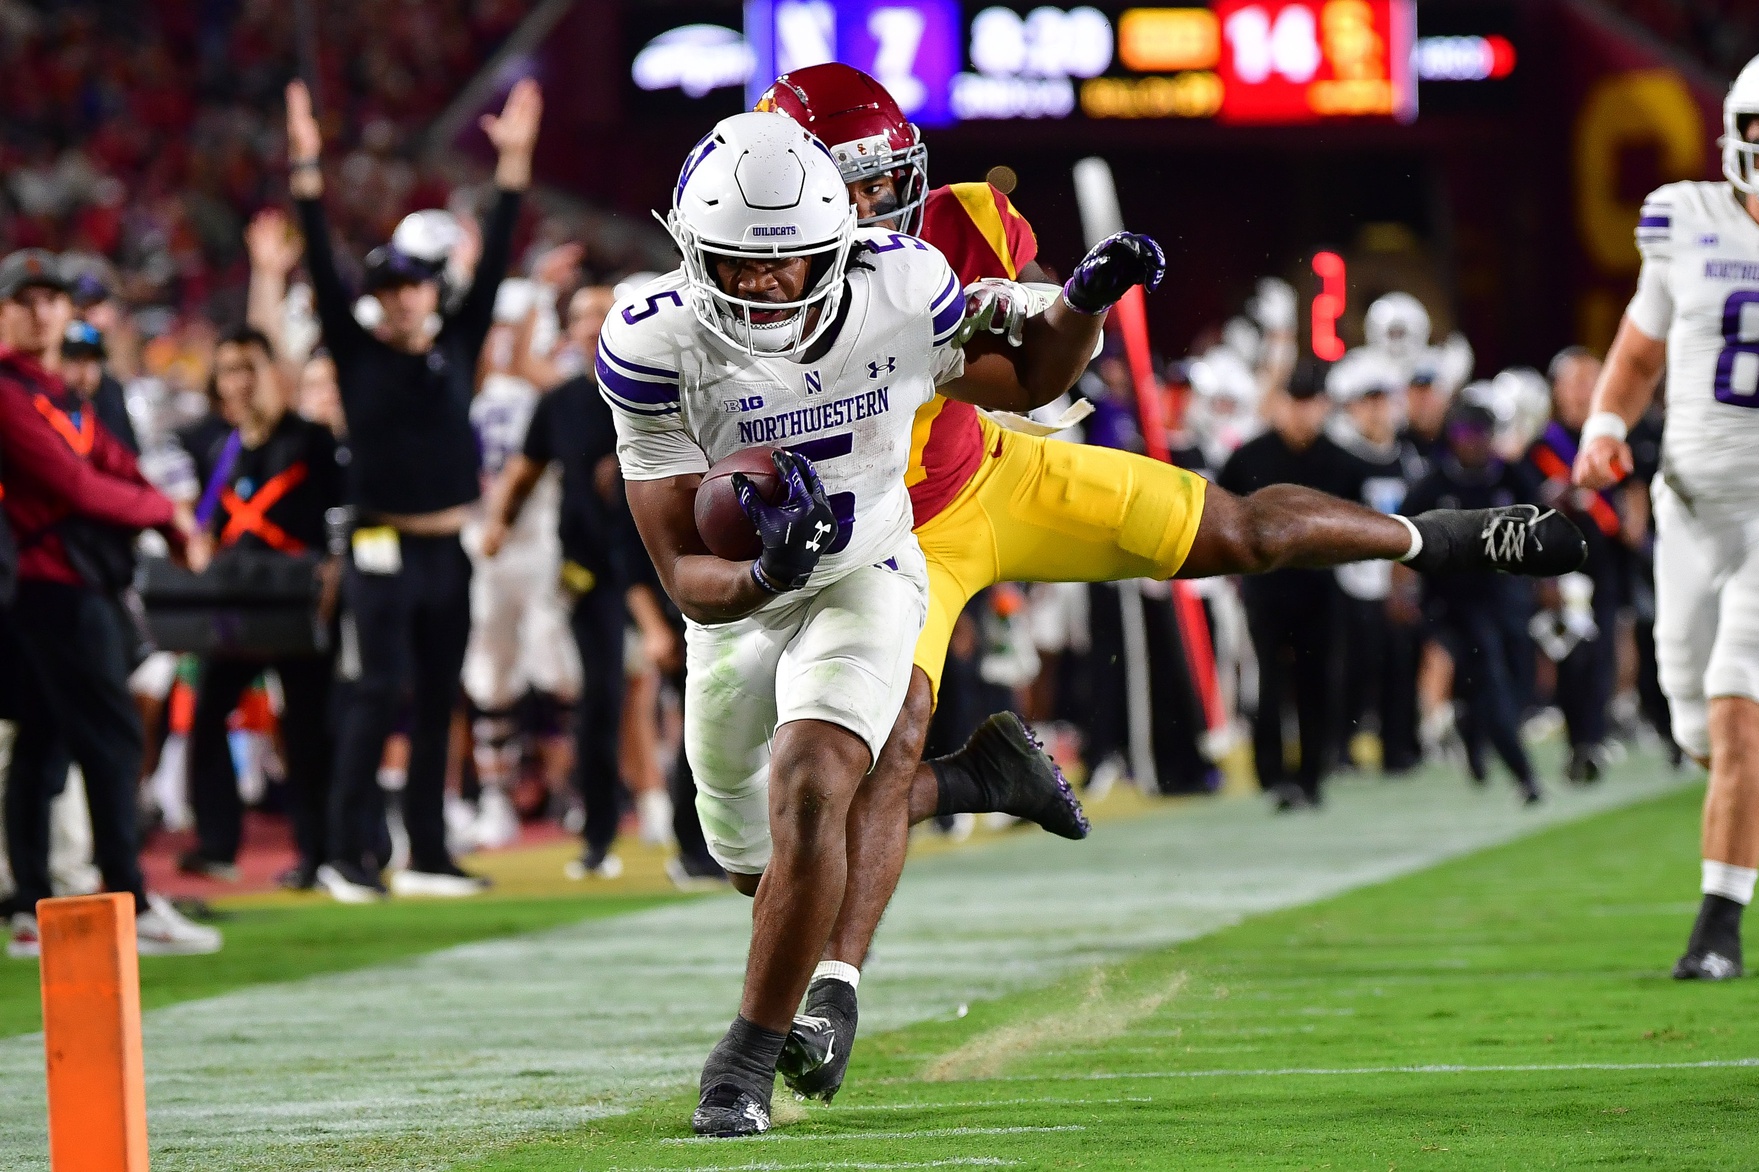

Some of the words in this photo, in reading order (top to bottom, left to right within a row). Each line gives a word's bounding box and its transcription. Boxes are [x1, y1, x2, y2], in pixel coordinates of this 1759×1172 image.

[1225, 4, 1321, 83] 14
[752, 226, 797, 237] WILDCATS
[863, 234, 929, 255] 5
[621, 290, 684, 325] 5
[803, 370, 822, 395] N
[738, 386, 890, 443] NORTHWESTERN
